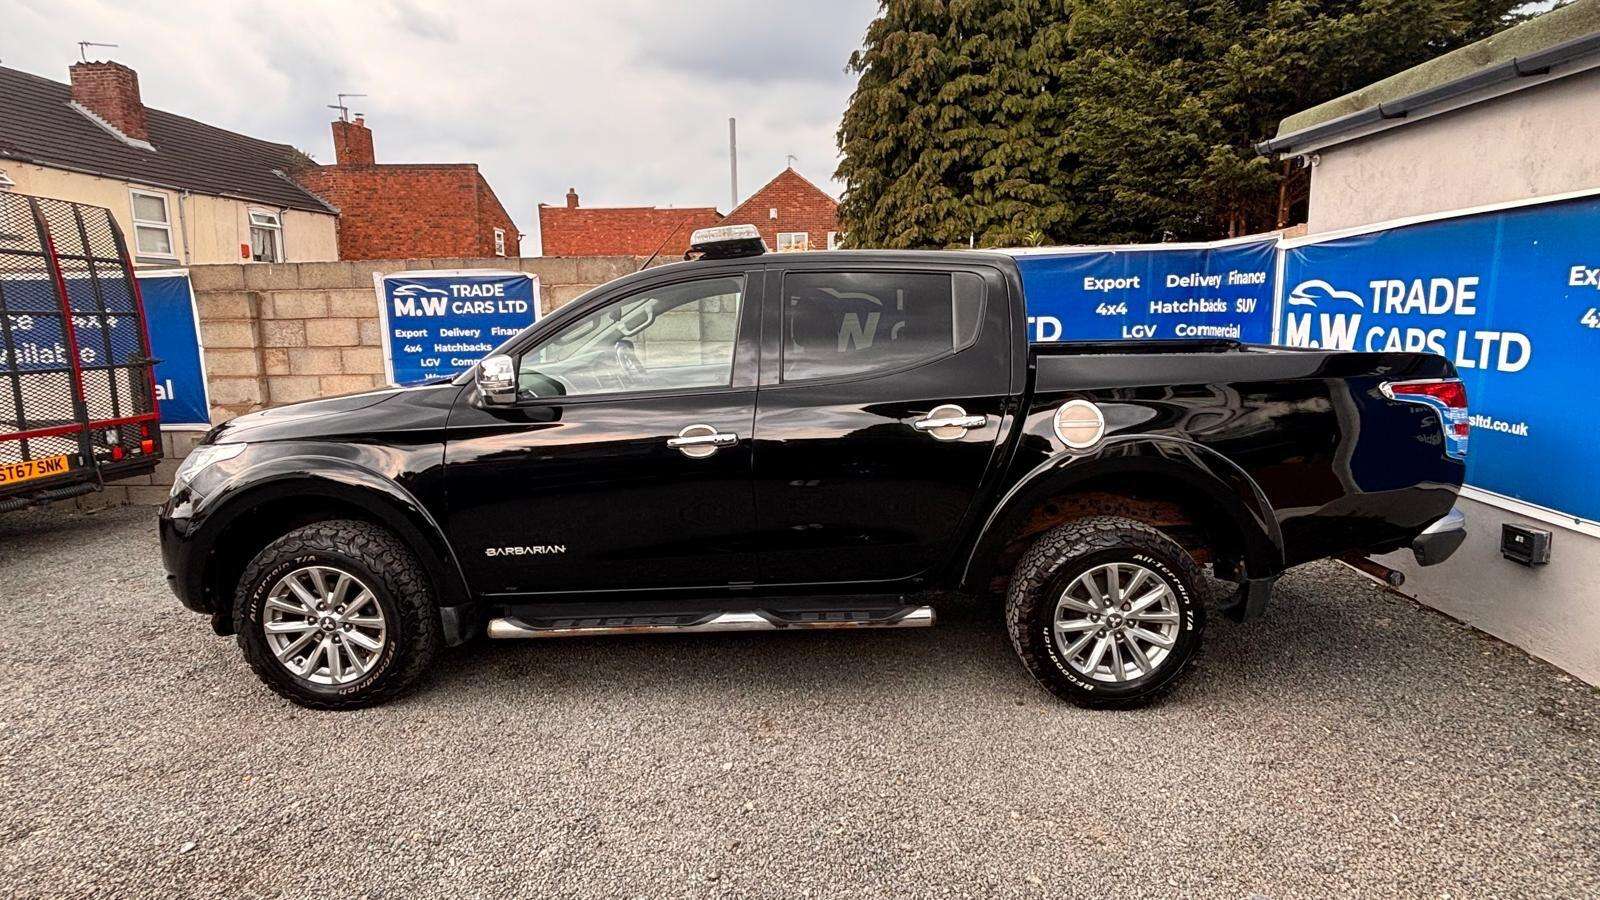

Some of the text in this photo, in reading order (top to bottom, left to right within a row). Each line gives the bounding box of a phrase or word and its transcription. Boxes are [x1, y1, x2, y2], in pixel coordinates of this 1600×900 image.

[1084, 270, 1266, 293] Export Delivery Finance
[1568, 265, 1600, 291] Ex
[450, 284, 505, 298] TRADE
[1369, 276, 1480, 315] TRADE
[393, 296, 449, 317] M.W
[452, 299, 528, 315] CARS LTD
[1095, 298, 1257, 316] 4x4 Hatchbacks SUV
[395, 328, 429, 339] Export
[440, 327, 481, 338] Delivery
[1122, 323, 1241, 339] LGV Commercial
[1286, 312, 1362, 351] M.W
[404, 342, 492, 353] 4x4 Hatchbacks
[1365, 326, 1533, 374] CARS LTD
[420, 358, 440, 367] LGV
[1468, 414, 1528, 437] sltd.co.uk
[0, 457, 64, 482] ST67 SNK
[485, 545, 566, 557] BARBARIAN
[1132, 554, 1194, 631] All-Terrain T/A
[1043, 627, 1095, 691] BFGoodrich
